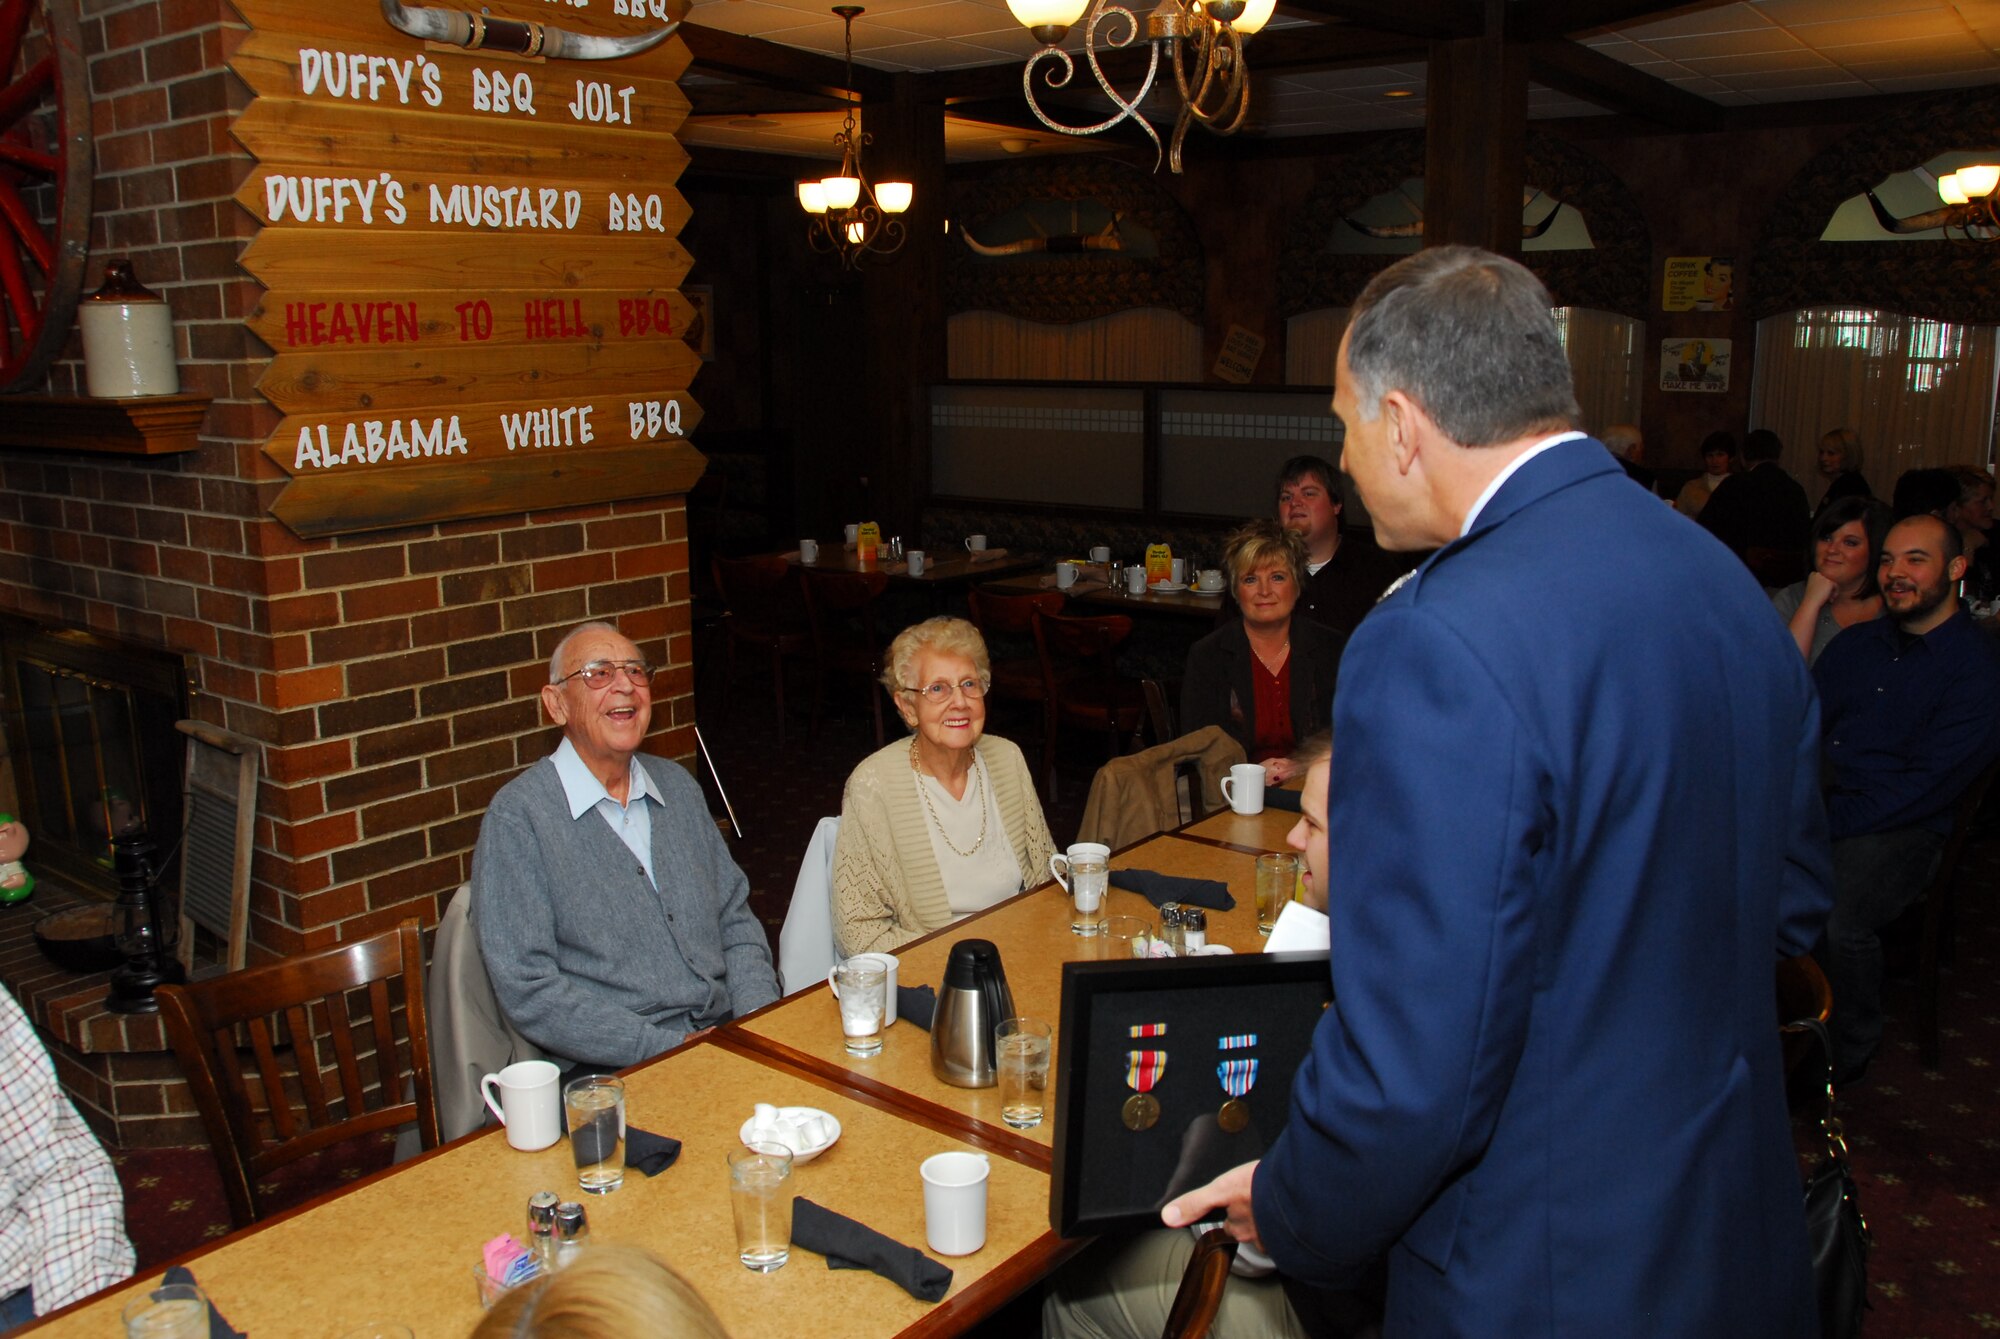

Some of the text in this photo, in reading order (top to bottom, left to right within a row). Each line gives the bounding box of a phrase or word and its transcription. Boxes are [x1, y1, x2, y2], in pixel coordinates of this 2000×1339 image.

[299, 48, 636, 125] DUFFY'S BBQ JOLT
[265, 172, 666, 233] DUFFY'S MUSTARD BBQ
[1667, 270, 1699, 278] COFFEE
[285, 298, 673, 347] HEAVEN TO HELL BBQ
[1219, 356, 1252, 378] WELCOME
[294, 399, 685, 469] ALABAMA WHITE BBQ
